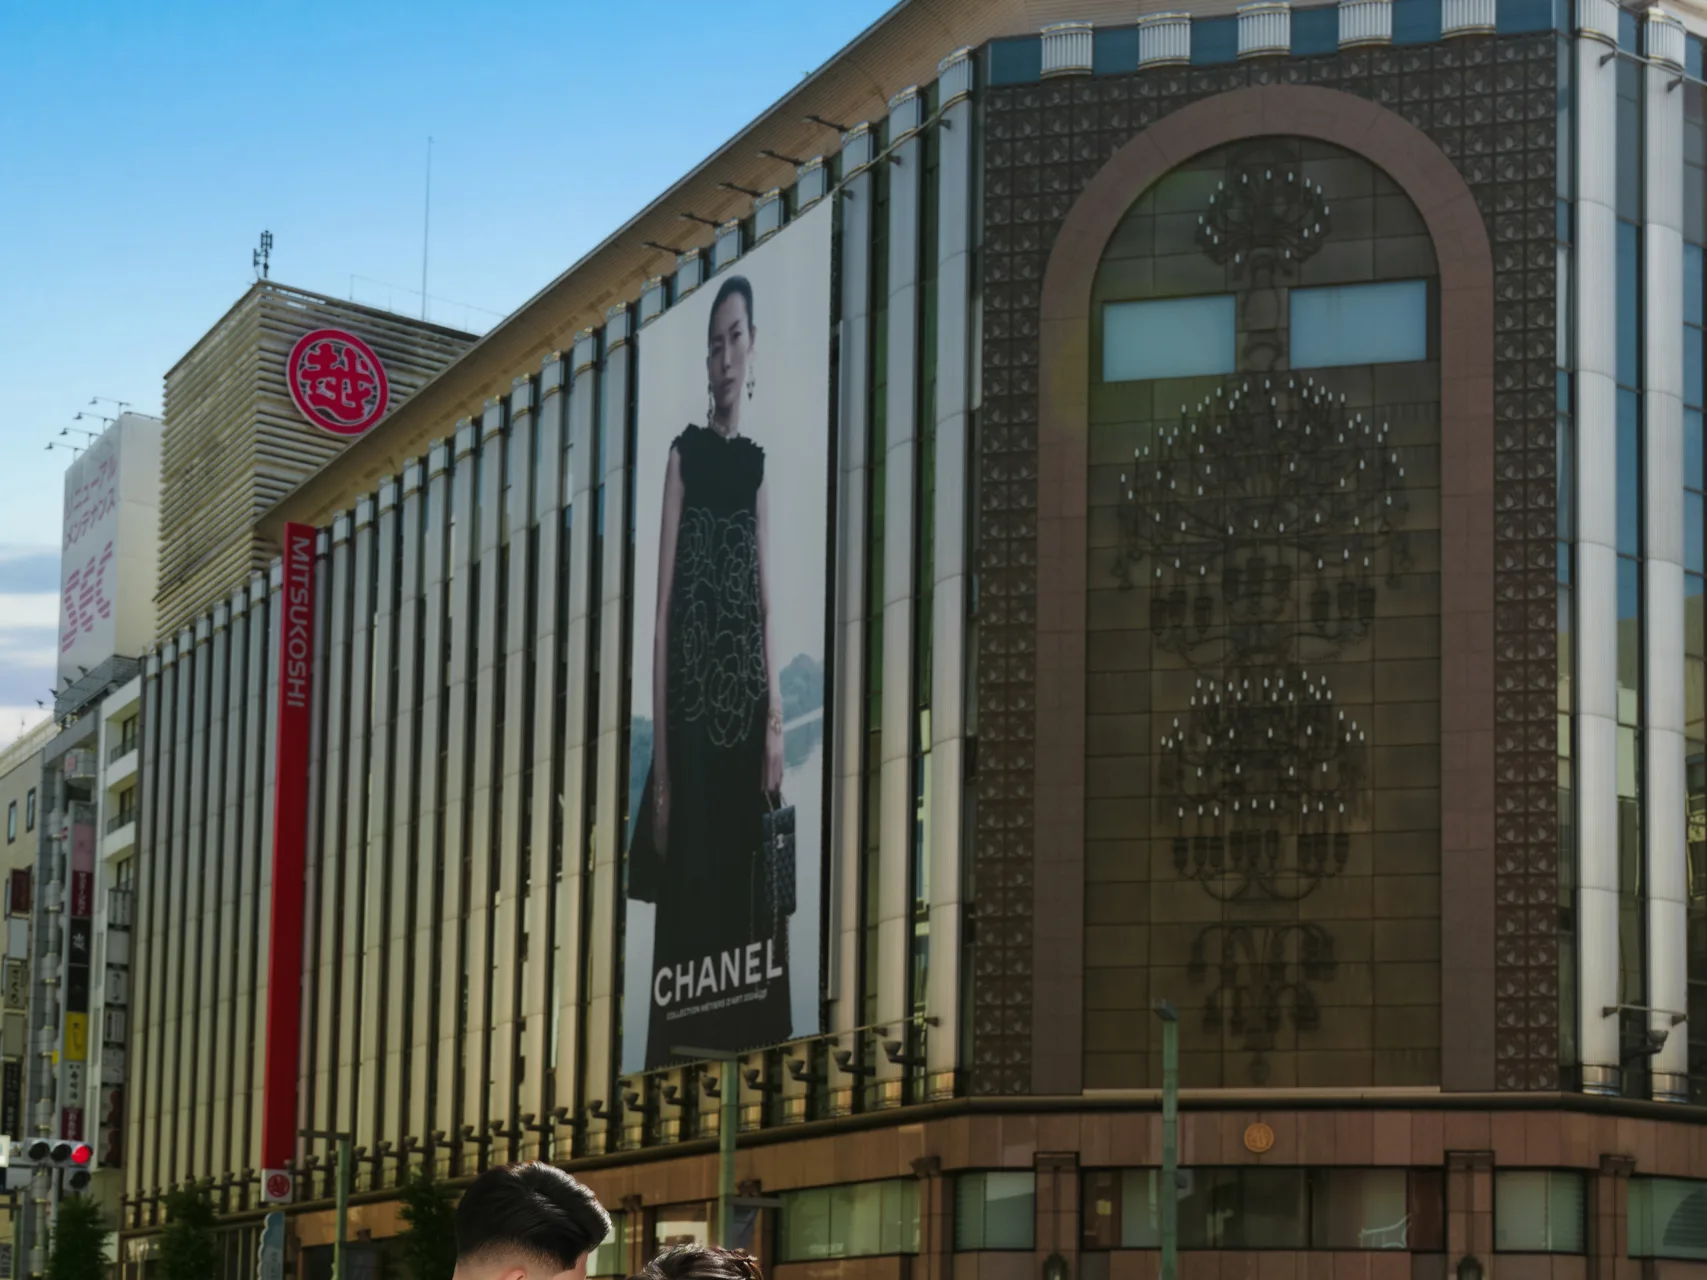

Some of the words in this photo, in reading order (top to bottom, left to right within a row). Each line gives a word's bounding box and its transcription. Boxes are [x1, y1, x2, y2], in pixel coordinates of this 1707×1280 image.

[299, 341, 377, 421] 越
[64, 487, 116, 552] メンテナンス
[287, 535, 311, 707] MITSUKOSHI
[654, 938, 783, 1007] CHANEL
